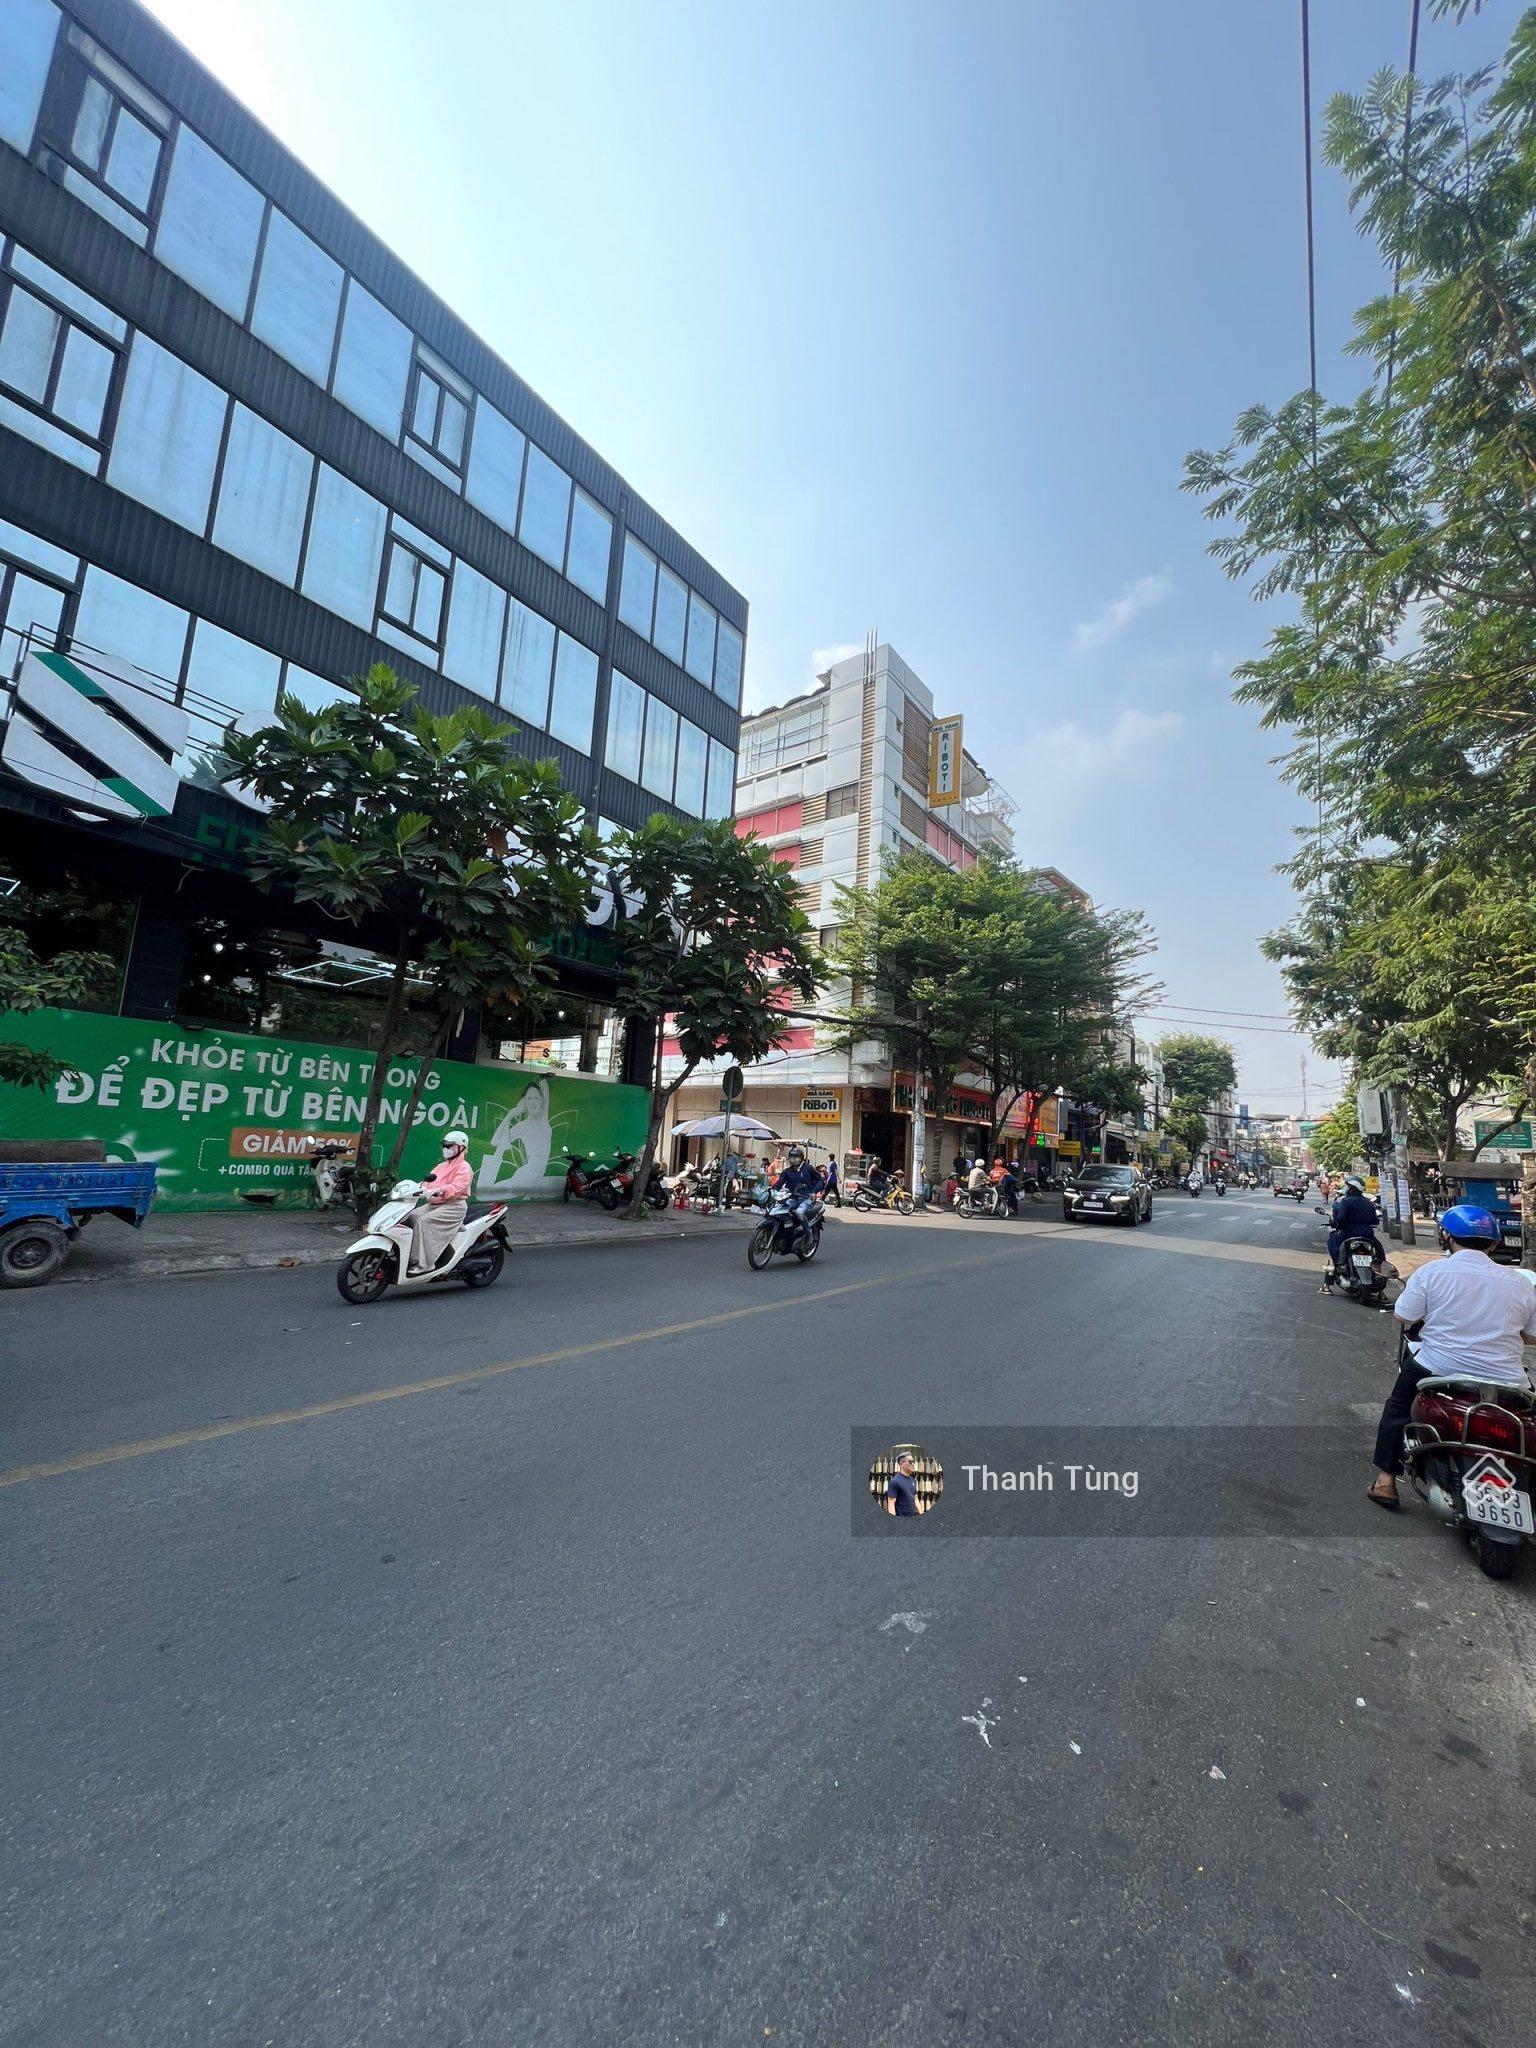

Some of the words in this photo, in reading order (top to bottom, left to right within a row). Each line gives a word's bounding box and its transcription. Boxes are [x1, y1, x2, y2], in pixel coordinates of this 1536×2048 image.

[151, 1037, 246, 1071] KHỎE
[256, 1047, 293, 1076] TỪ
[299, 1053, 351, 1083] BÊN
[359, 1064, 441, 1091] TONG
[55, 1055, 130, 1107] ĐỂ
[140, 1077, 229, 1121] ĐẸP
[242, 1079, 293, 1118] TỪ
[301, 1086, 368, 1123] BÊN
[378, 1096, 479, 1129] NGOÀI
[242, 1129, 308, 1155] GIẢM
[1477, 1503, 1523, 1527] 9650
